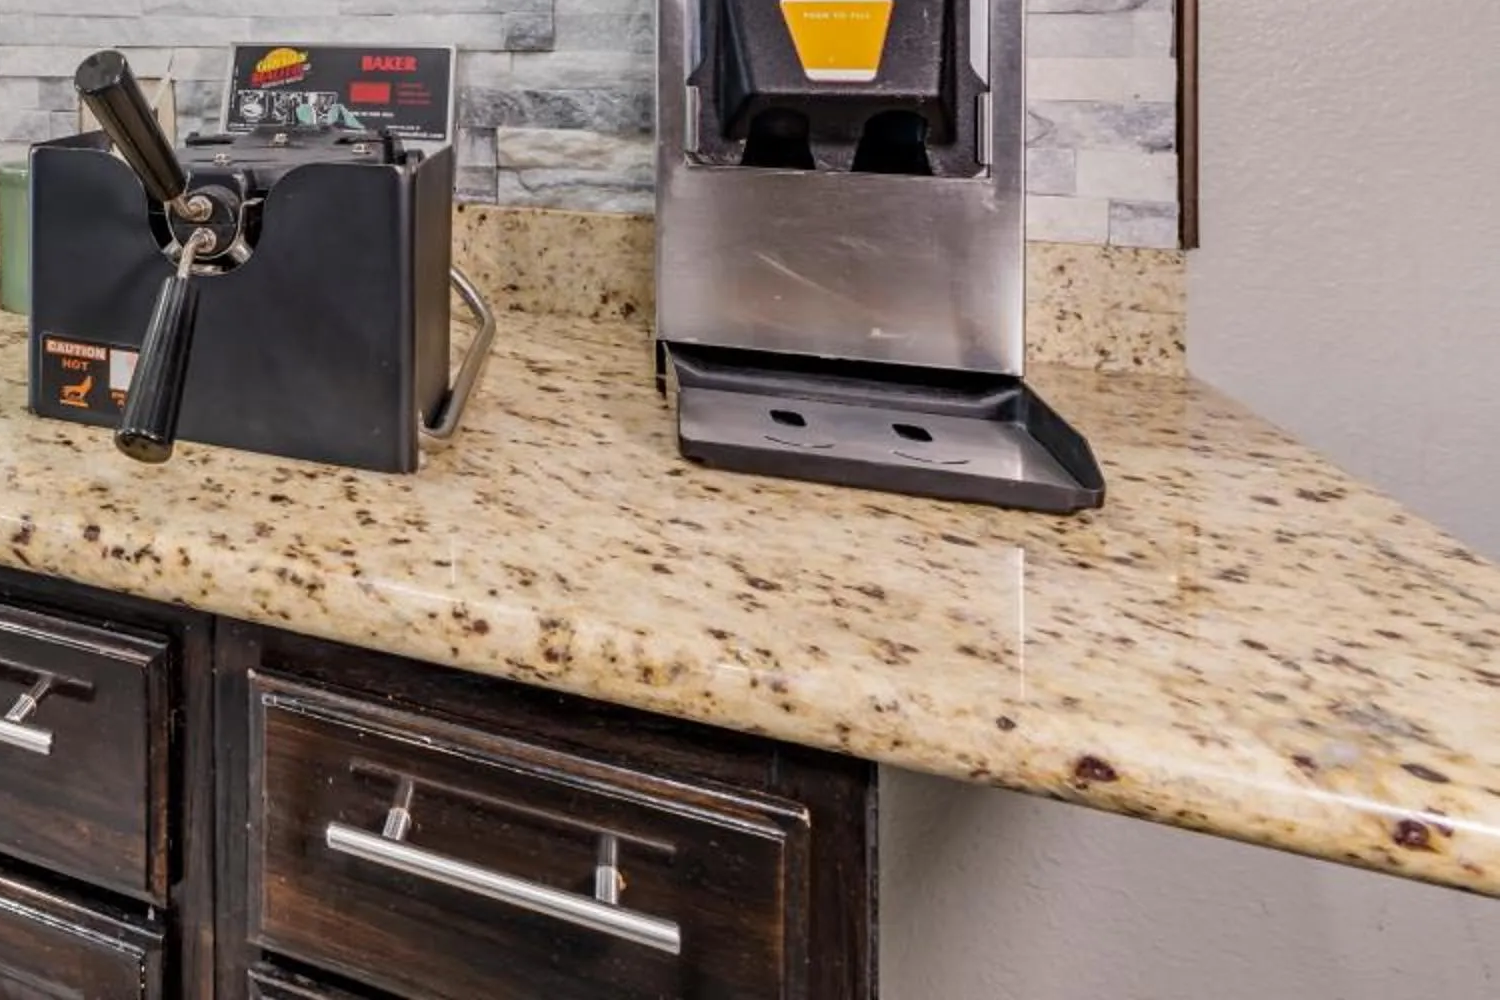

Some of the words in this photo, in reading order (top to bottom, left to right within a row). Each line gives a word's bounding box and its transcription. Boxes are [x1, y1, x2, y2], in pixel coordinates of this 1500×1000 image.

[361, 55, 418, 73] BAKER
[45, 339, 107, 362] CAUTION
[62, 358, 90, 373] HOT
